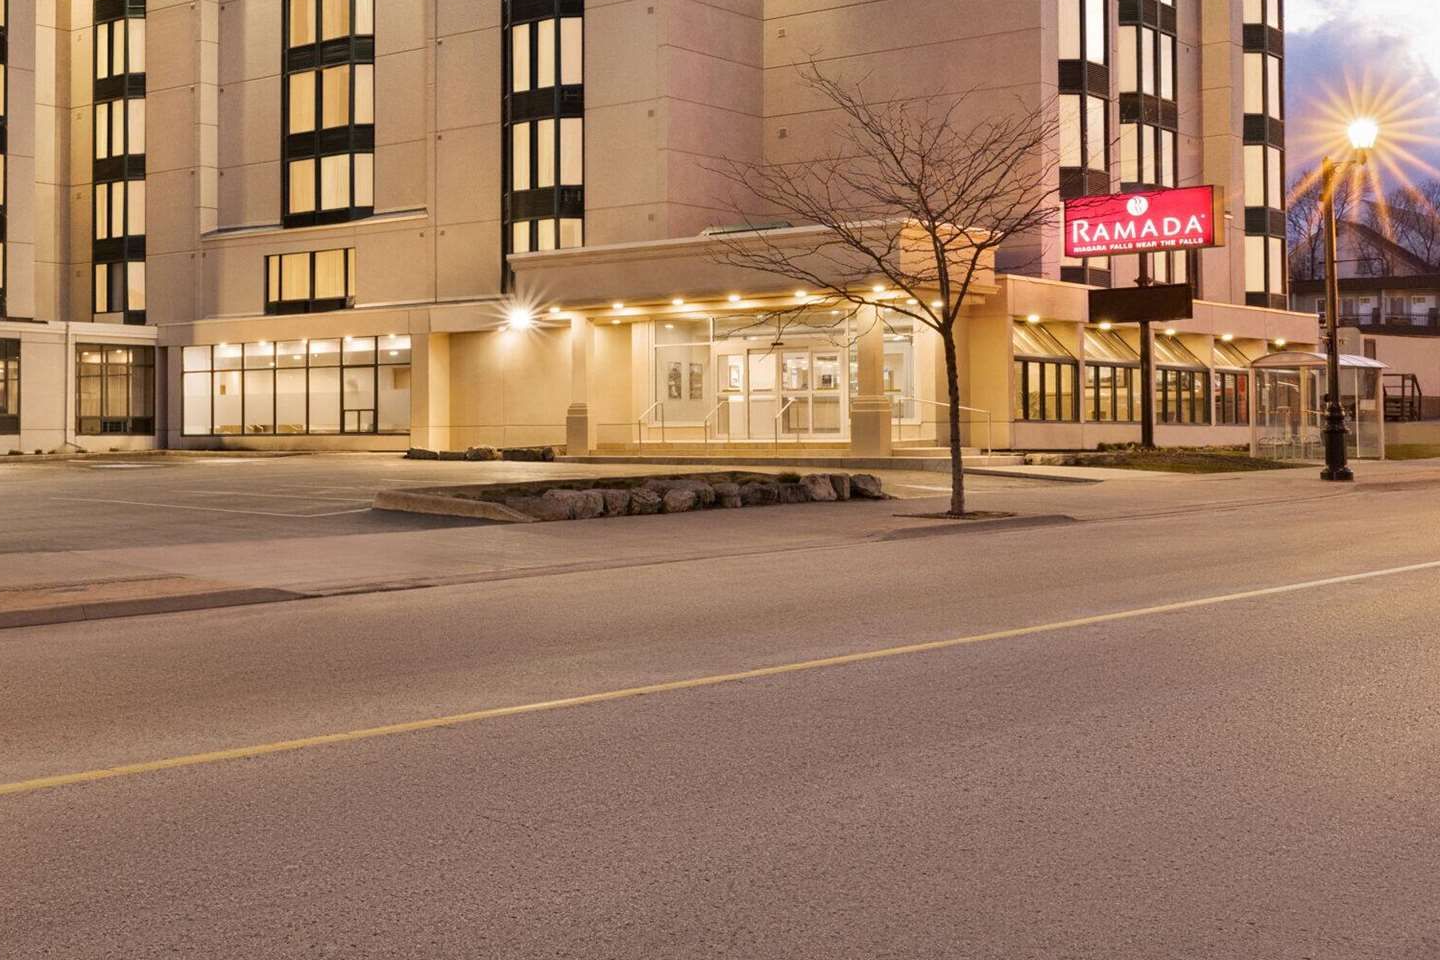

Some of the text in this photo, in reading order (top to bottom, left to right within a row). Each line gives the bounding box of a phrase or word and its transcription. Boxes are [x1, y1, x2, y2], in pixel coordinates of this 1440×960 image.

[1072, 215, 1203, 243] RAMADA
[1073, 237, 1204, 253] NIAGARA FALLS NEAR THE FALLS
